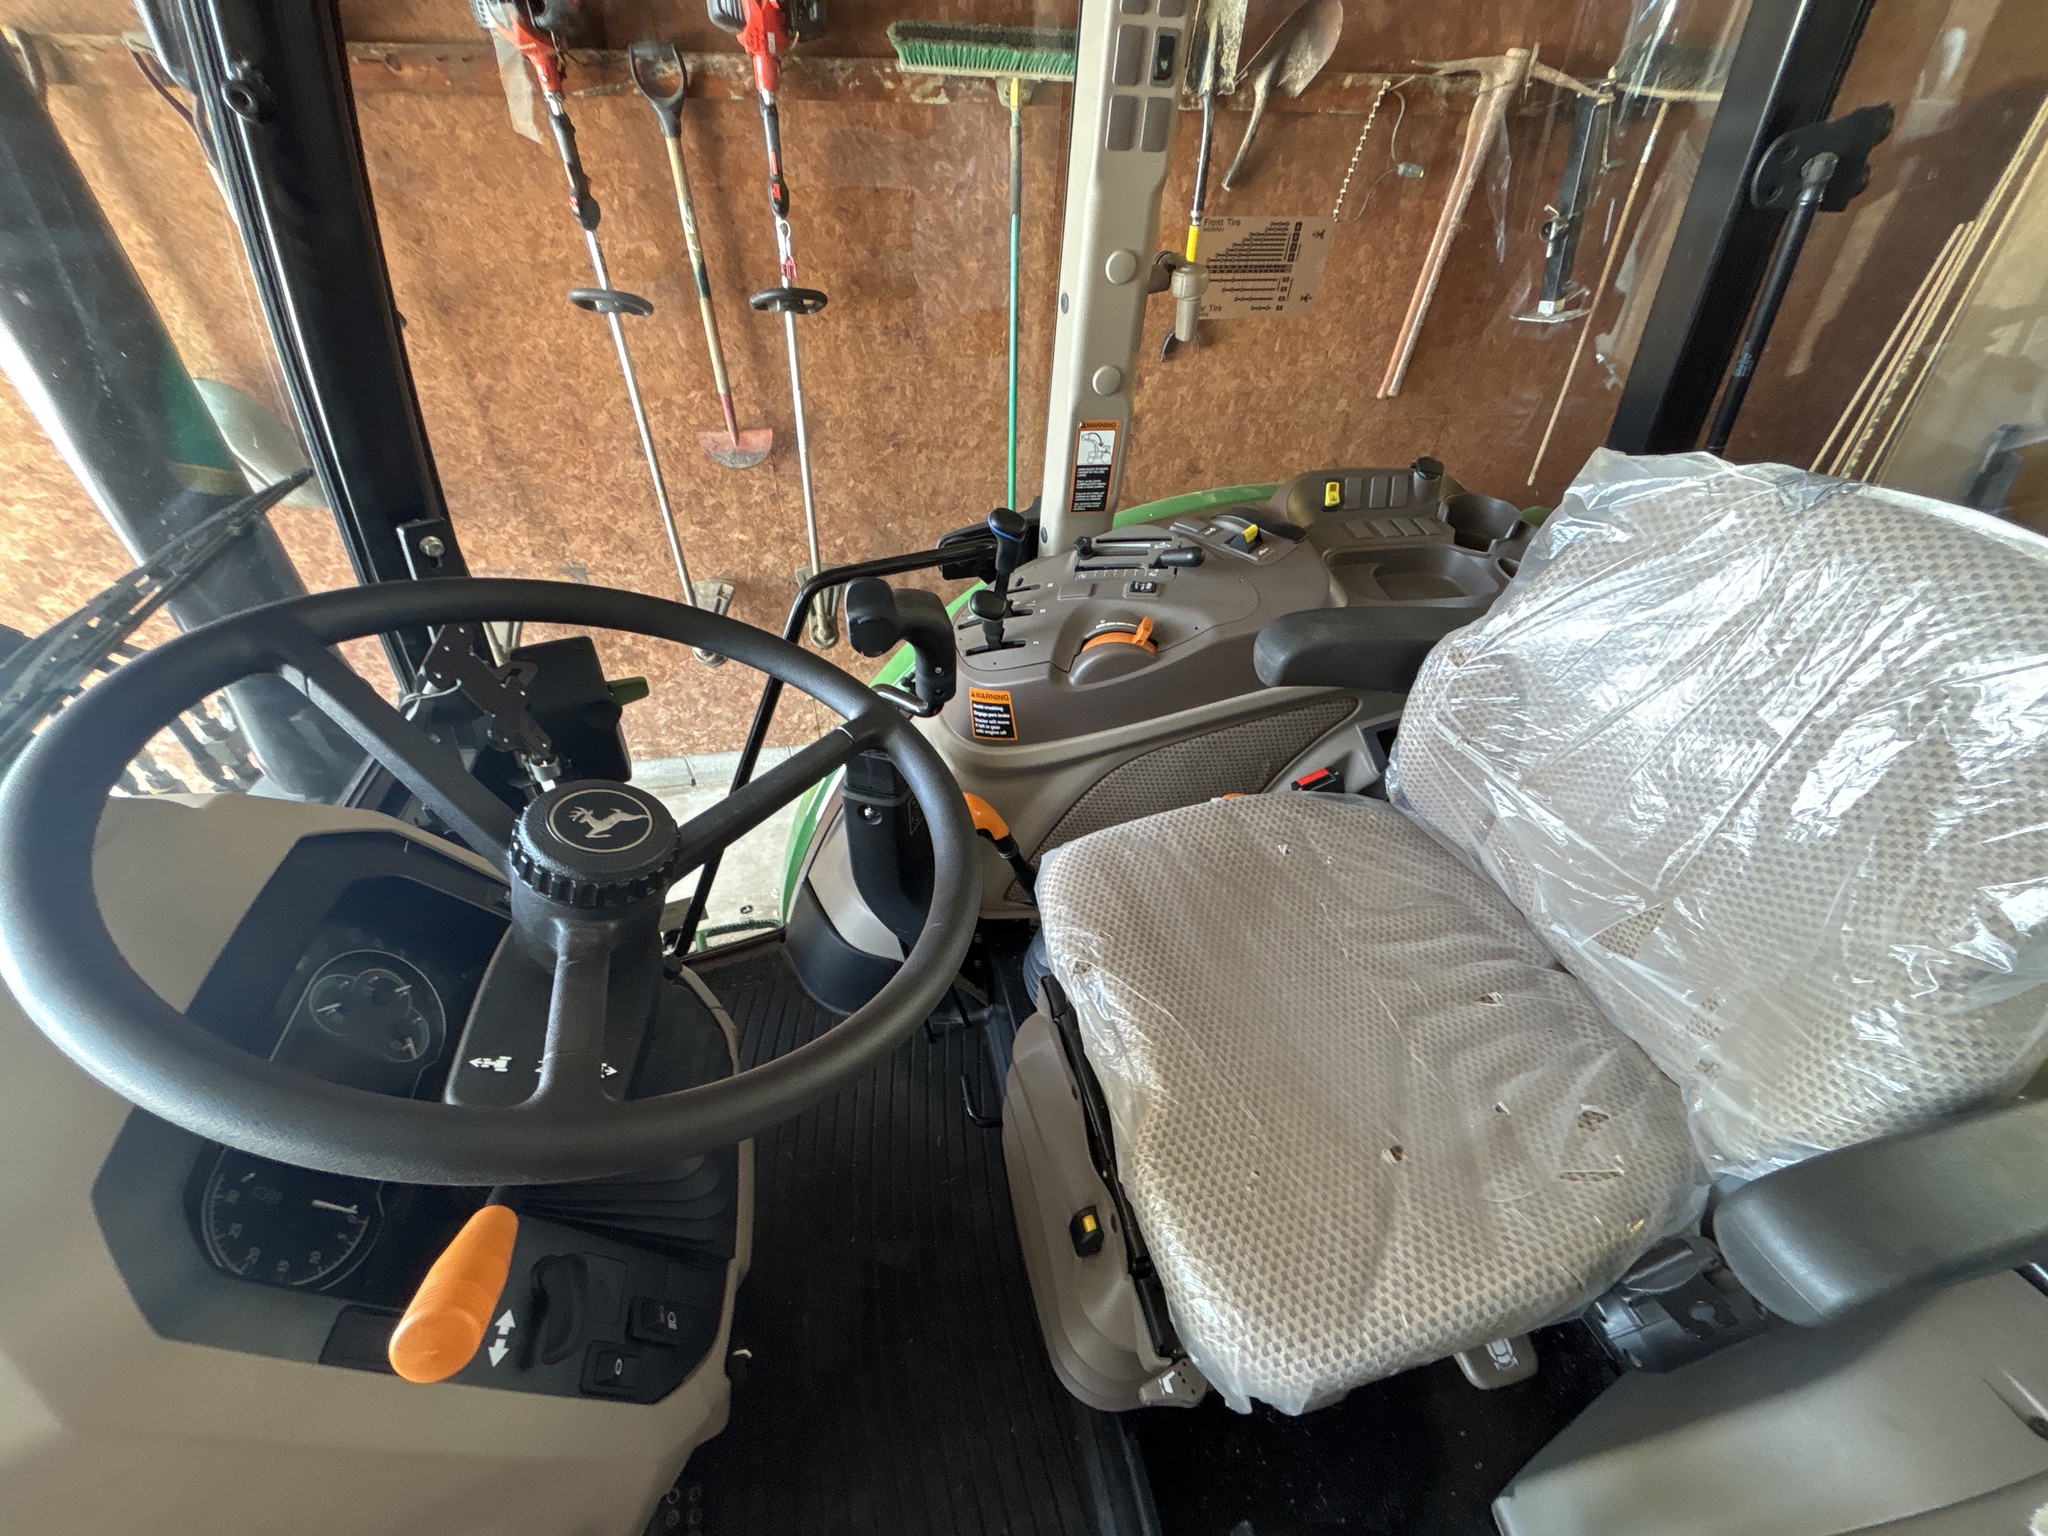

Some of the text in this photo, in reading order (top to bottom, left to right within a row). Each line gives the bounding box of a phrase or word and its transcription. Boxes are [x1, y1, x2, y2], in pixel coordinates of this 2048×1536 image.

[1203, 218, 1241, 226] Front Tire
[976, 693, 1009, 701] WARNING
